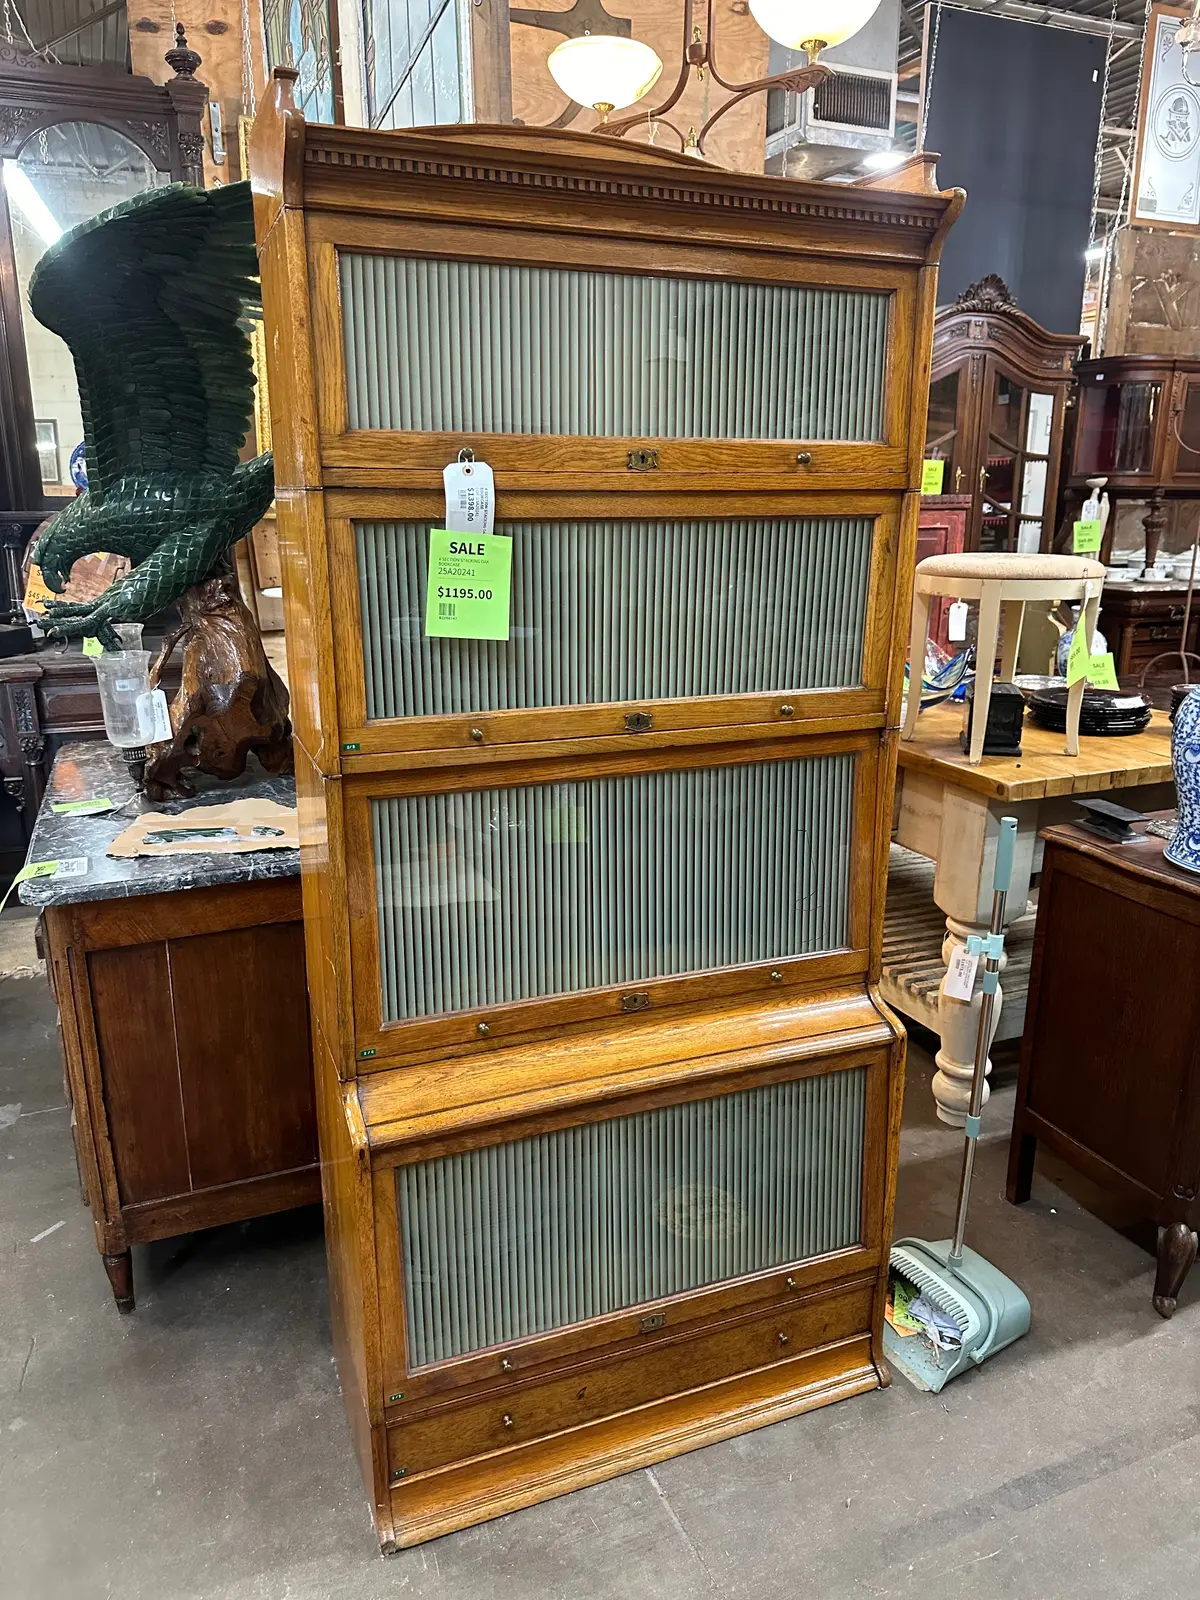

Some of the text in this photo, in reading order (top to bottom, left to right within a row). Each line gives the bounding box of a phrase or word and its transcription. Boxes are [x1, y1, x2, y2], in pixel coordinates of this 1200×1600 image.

[467, 487, 475, 522] $1398.00
[449, 541, 485, 556] SALE
[438, 567, 475, 577] 25A20241
[28, 591, 49, 600] $4500
[437, 586, 493, 600] $1195.00
